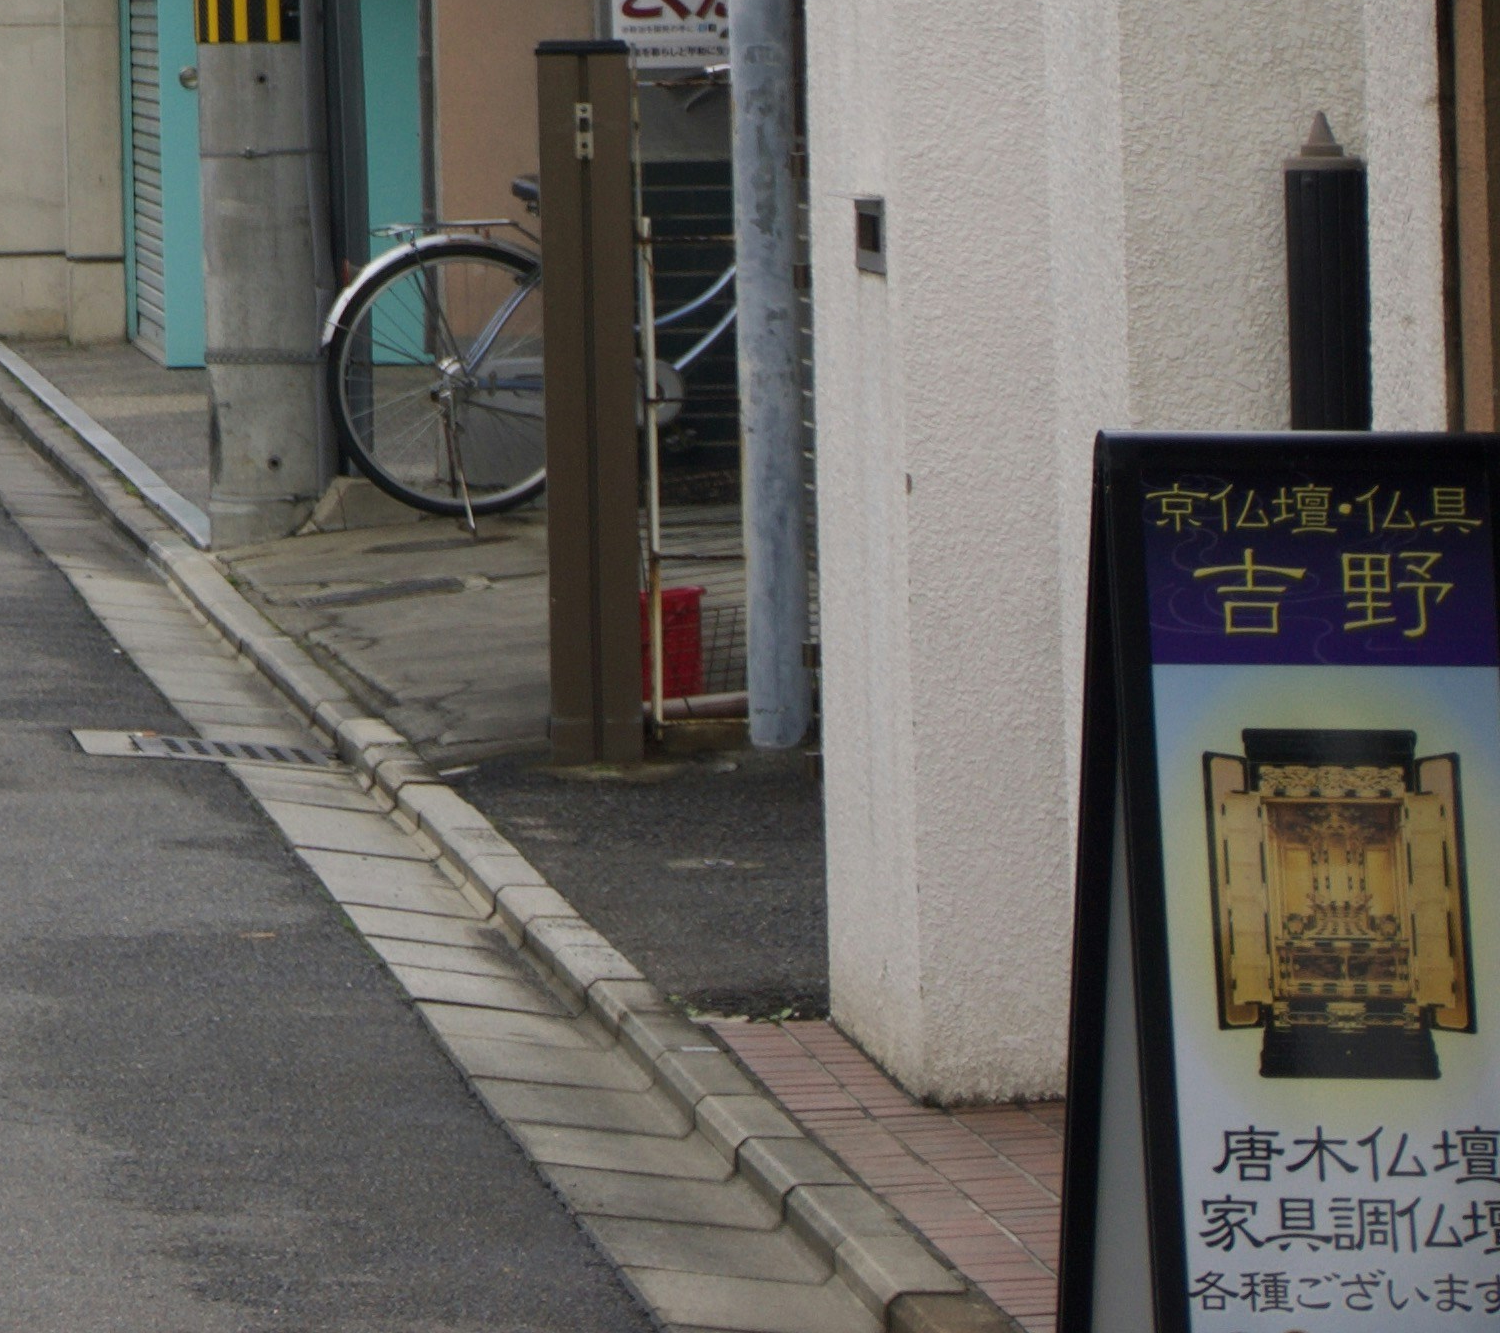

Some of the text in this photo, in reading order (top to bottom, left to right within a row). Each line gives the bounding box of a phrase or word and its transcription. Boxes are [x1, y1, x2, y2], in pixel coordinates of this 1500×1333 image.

[1146, 483, 1483, 533] 京仏壇・仏具
[1193, 548, 1454, 637] 吉野
[1212, 1125, 1500, 1184] 唐木仏壇
